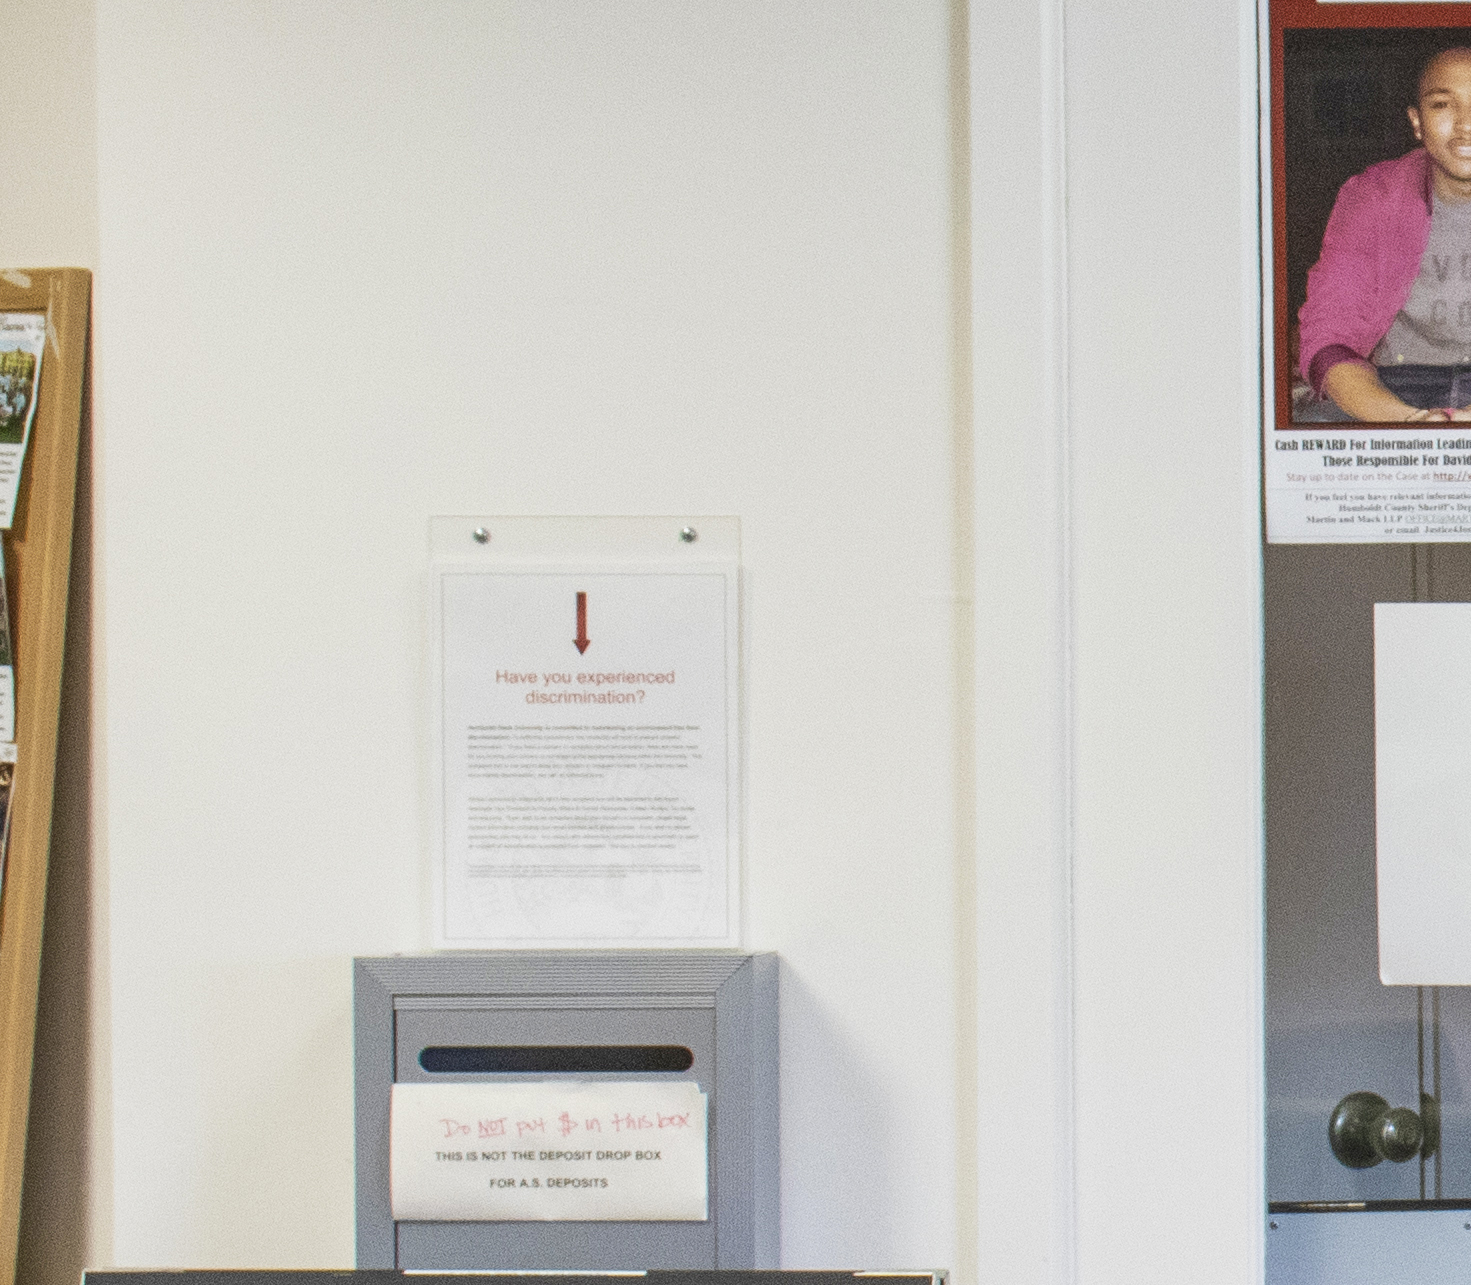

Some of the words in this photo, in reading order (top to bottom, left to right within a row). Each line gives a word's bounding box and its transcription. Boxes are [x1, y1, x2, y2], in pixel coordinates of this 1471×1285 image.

[1323, 455, 1352, 466] Those
[1356, 455, 1419, 467] Responsible
[1422, 455, 1438, 466] For
[496, 671, 538, 684] Have
[542, 673, 572, 687] you
[576, 670, 674, 687] experienced
[525, 690, 645, 704] discrimination?
[435, 1151, 463, 1162] THIS
[466, 1151, 478, 1162] IS
[482, 1151, 507, 1162] NOT
[512, 1151, 535, 1162] THE
[539, 1151, 592, 1162] DEPOSIT
[596, 1150, 632, 1161] DROP
[635, 1150, 661, 1161] BOX
